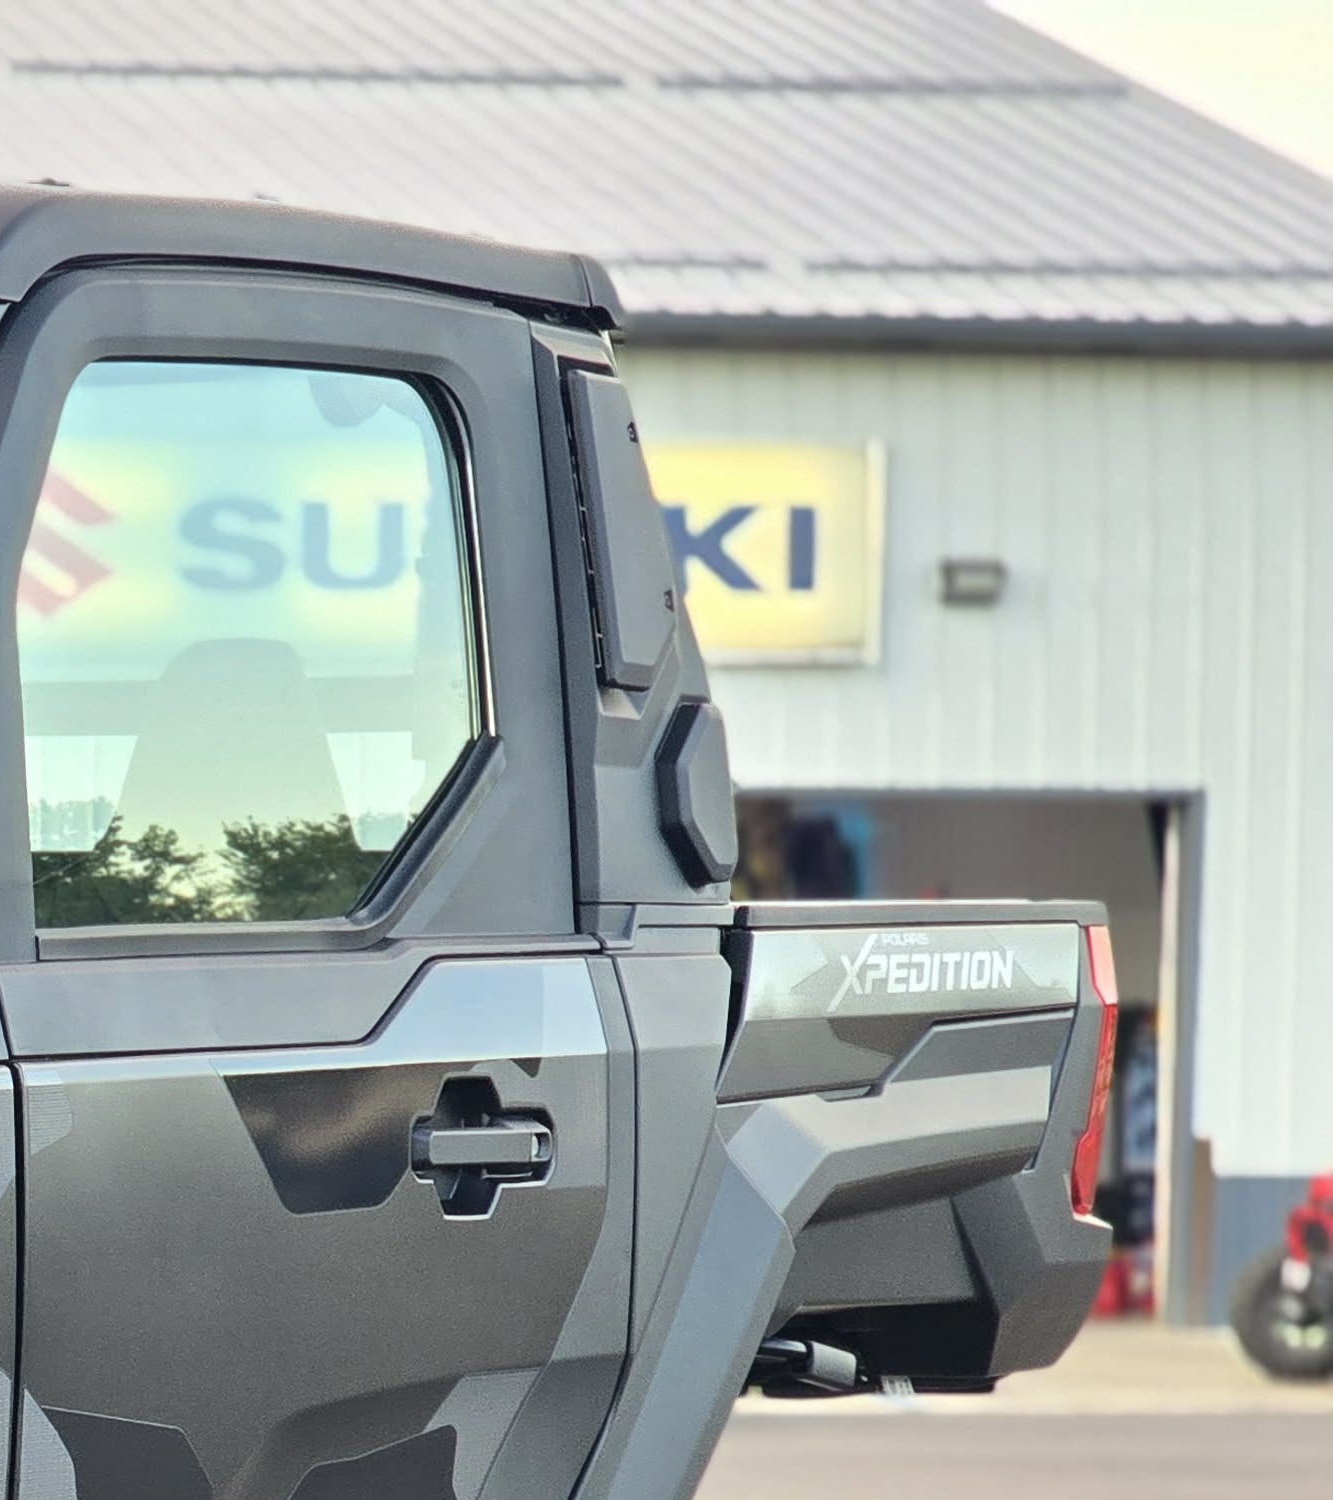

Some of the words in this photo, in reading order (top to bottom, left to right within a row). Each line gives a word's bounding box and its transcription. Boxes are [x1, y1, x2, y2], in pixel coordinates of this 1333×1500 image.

[176, 495, 816, 592] SUKI
[827, 933, 1015, 1013] XPEDITION
[882, 931, 930, 946] POLARIS
